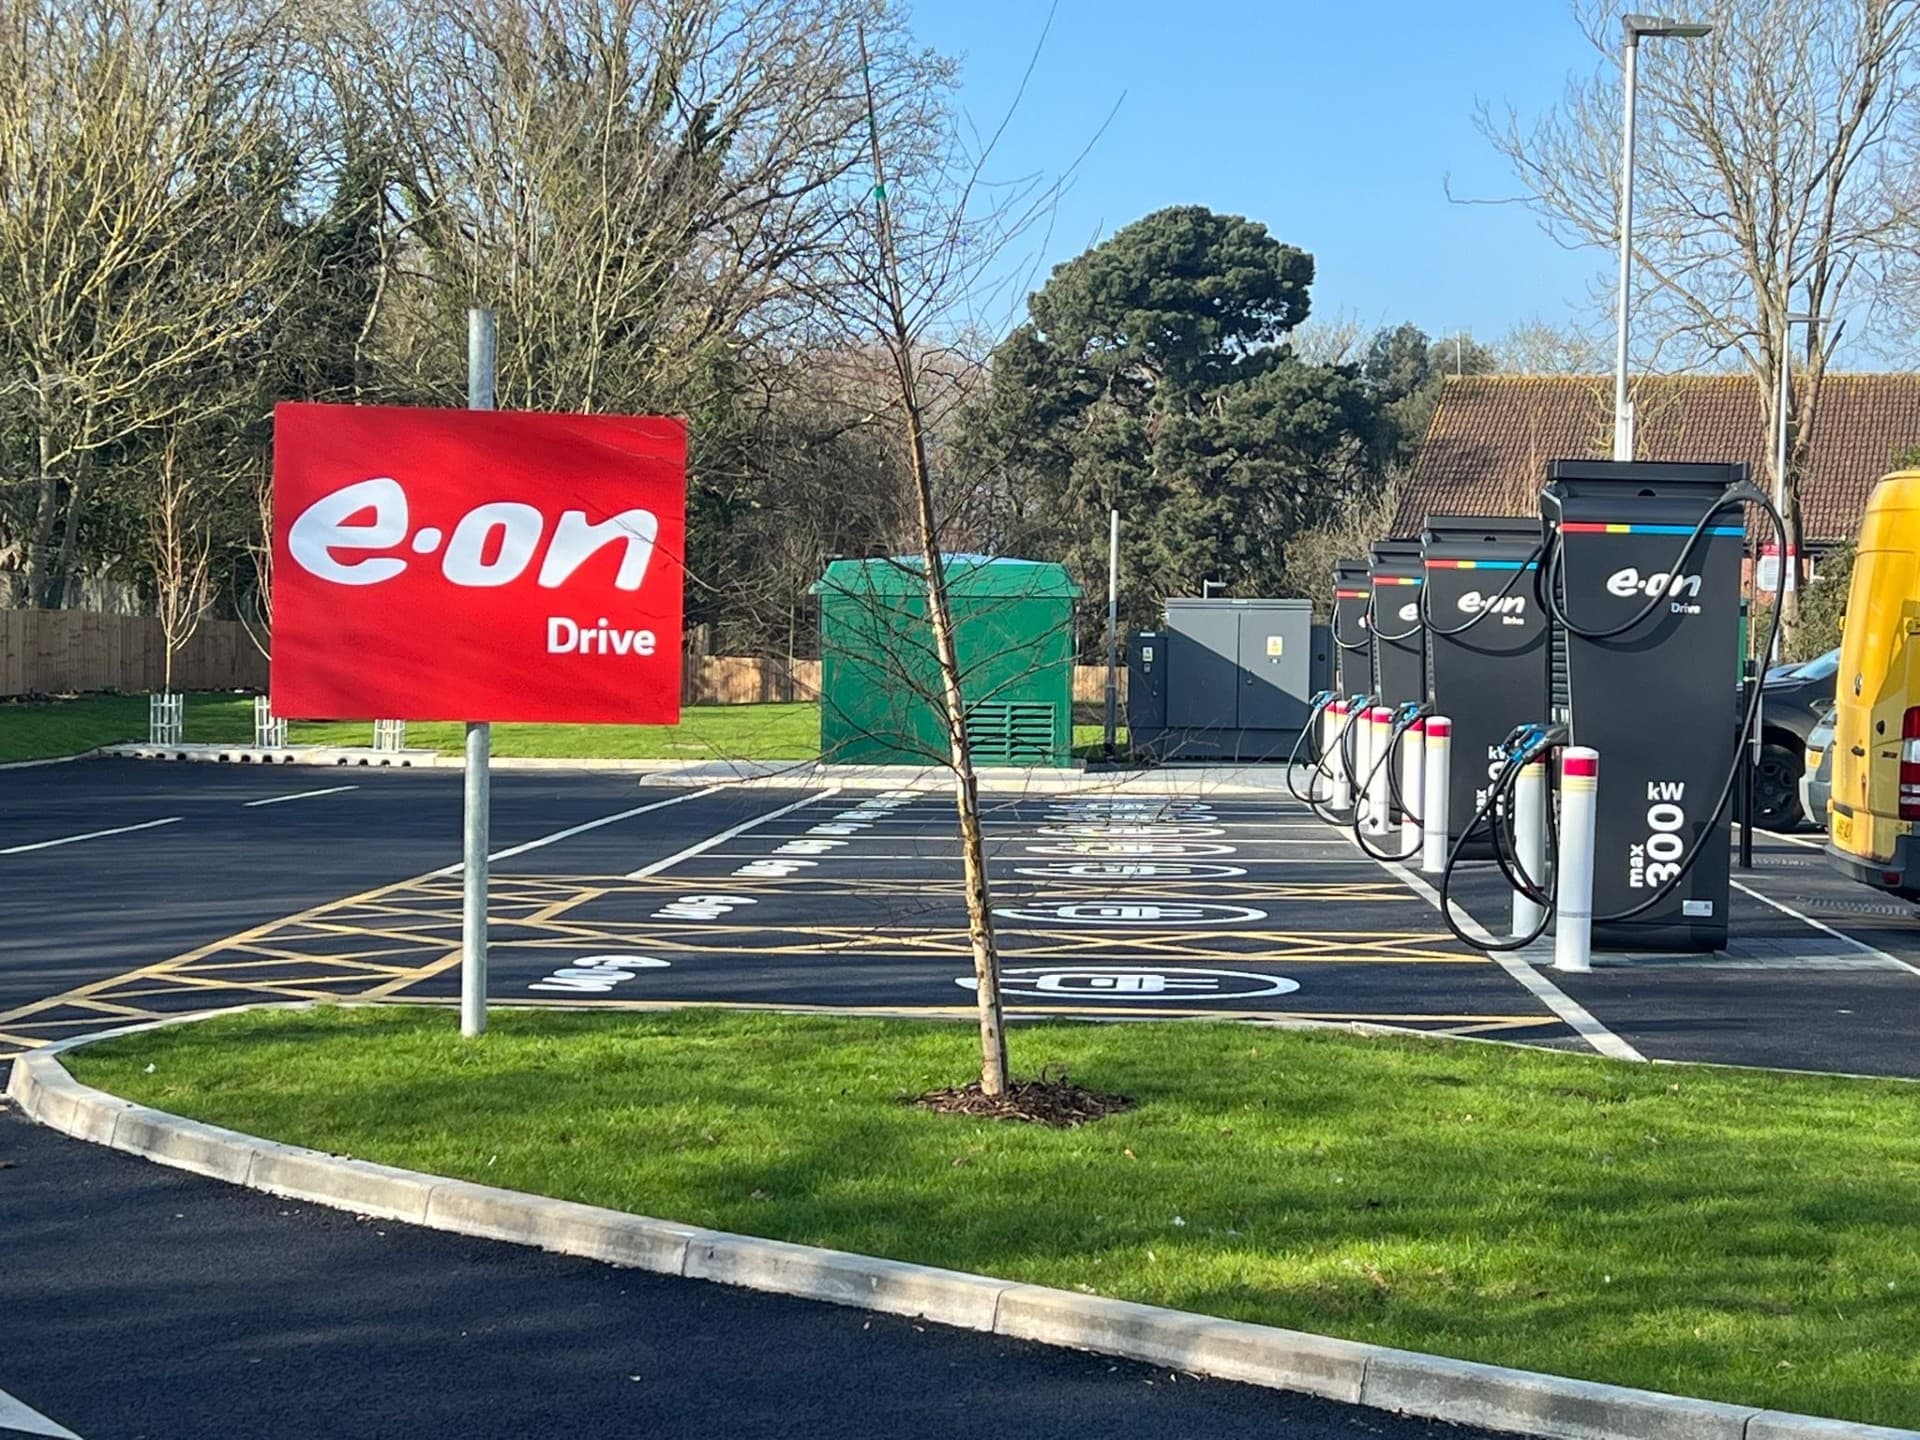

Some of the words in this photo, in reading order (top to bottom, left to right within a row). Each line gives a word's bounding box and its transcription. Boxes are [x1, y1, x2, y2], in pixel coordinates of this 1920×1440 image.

[1672, 603, 1701, 615] Drive
[548, 617, 656, 655] Drive
[1648, 782, 1685, 801] kW
[1645, 803, 1685, 888] 300
[1629, 843, 1645, 888] max
